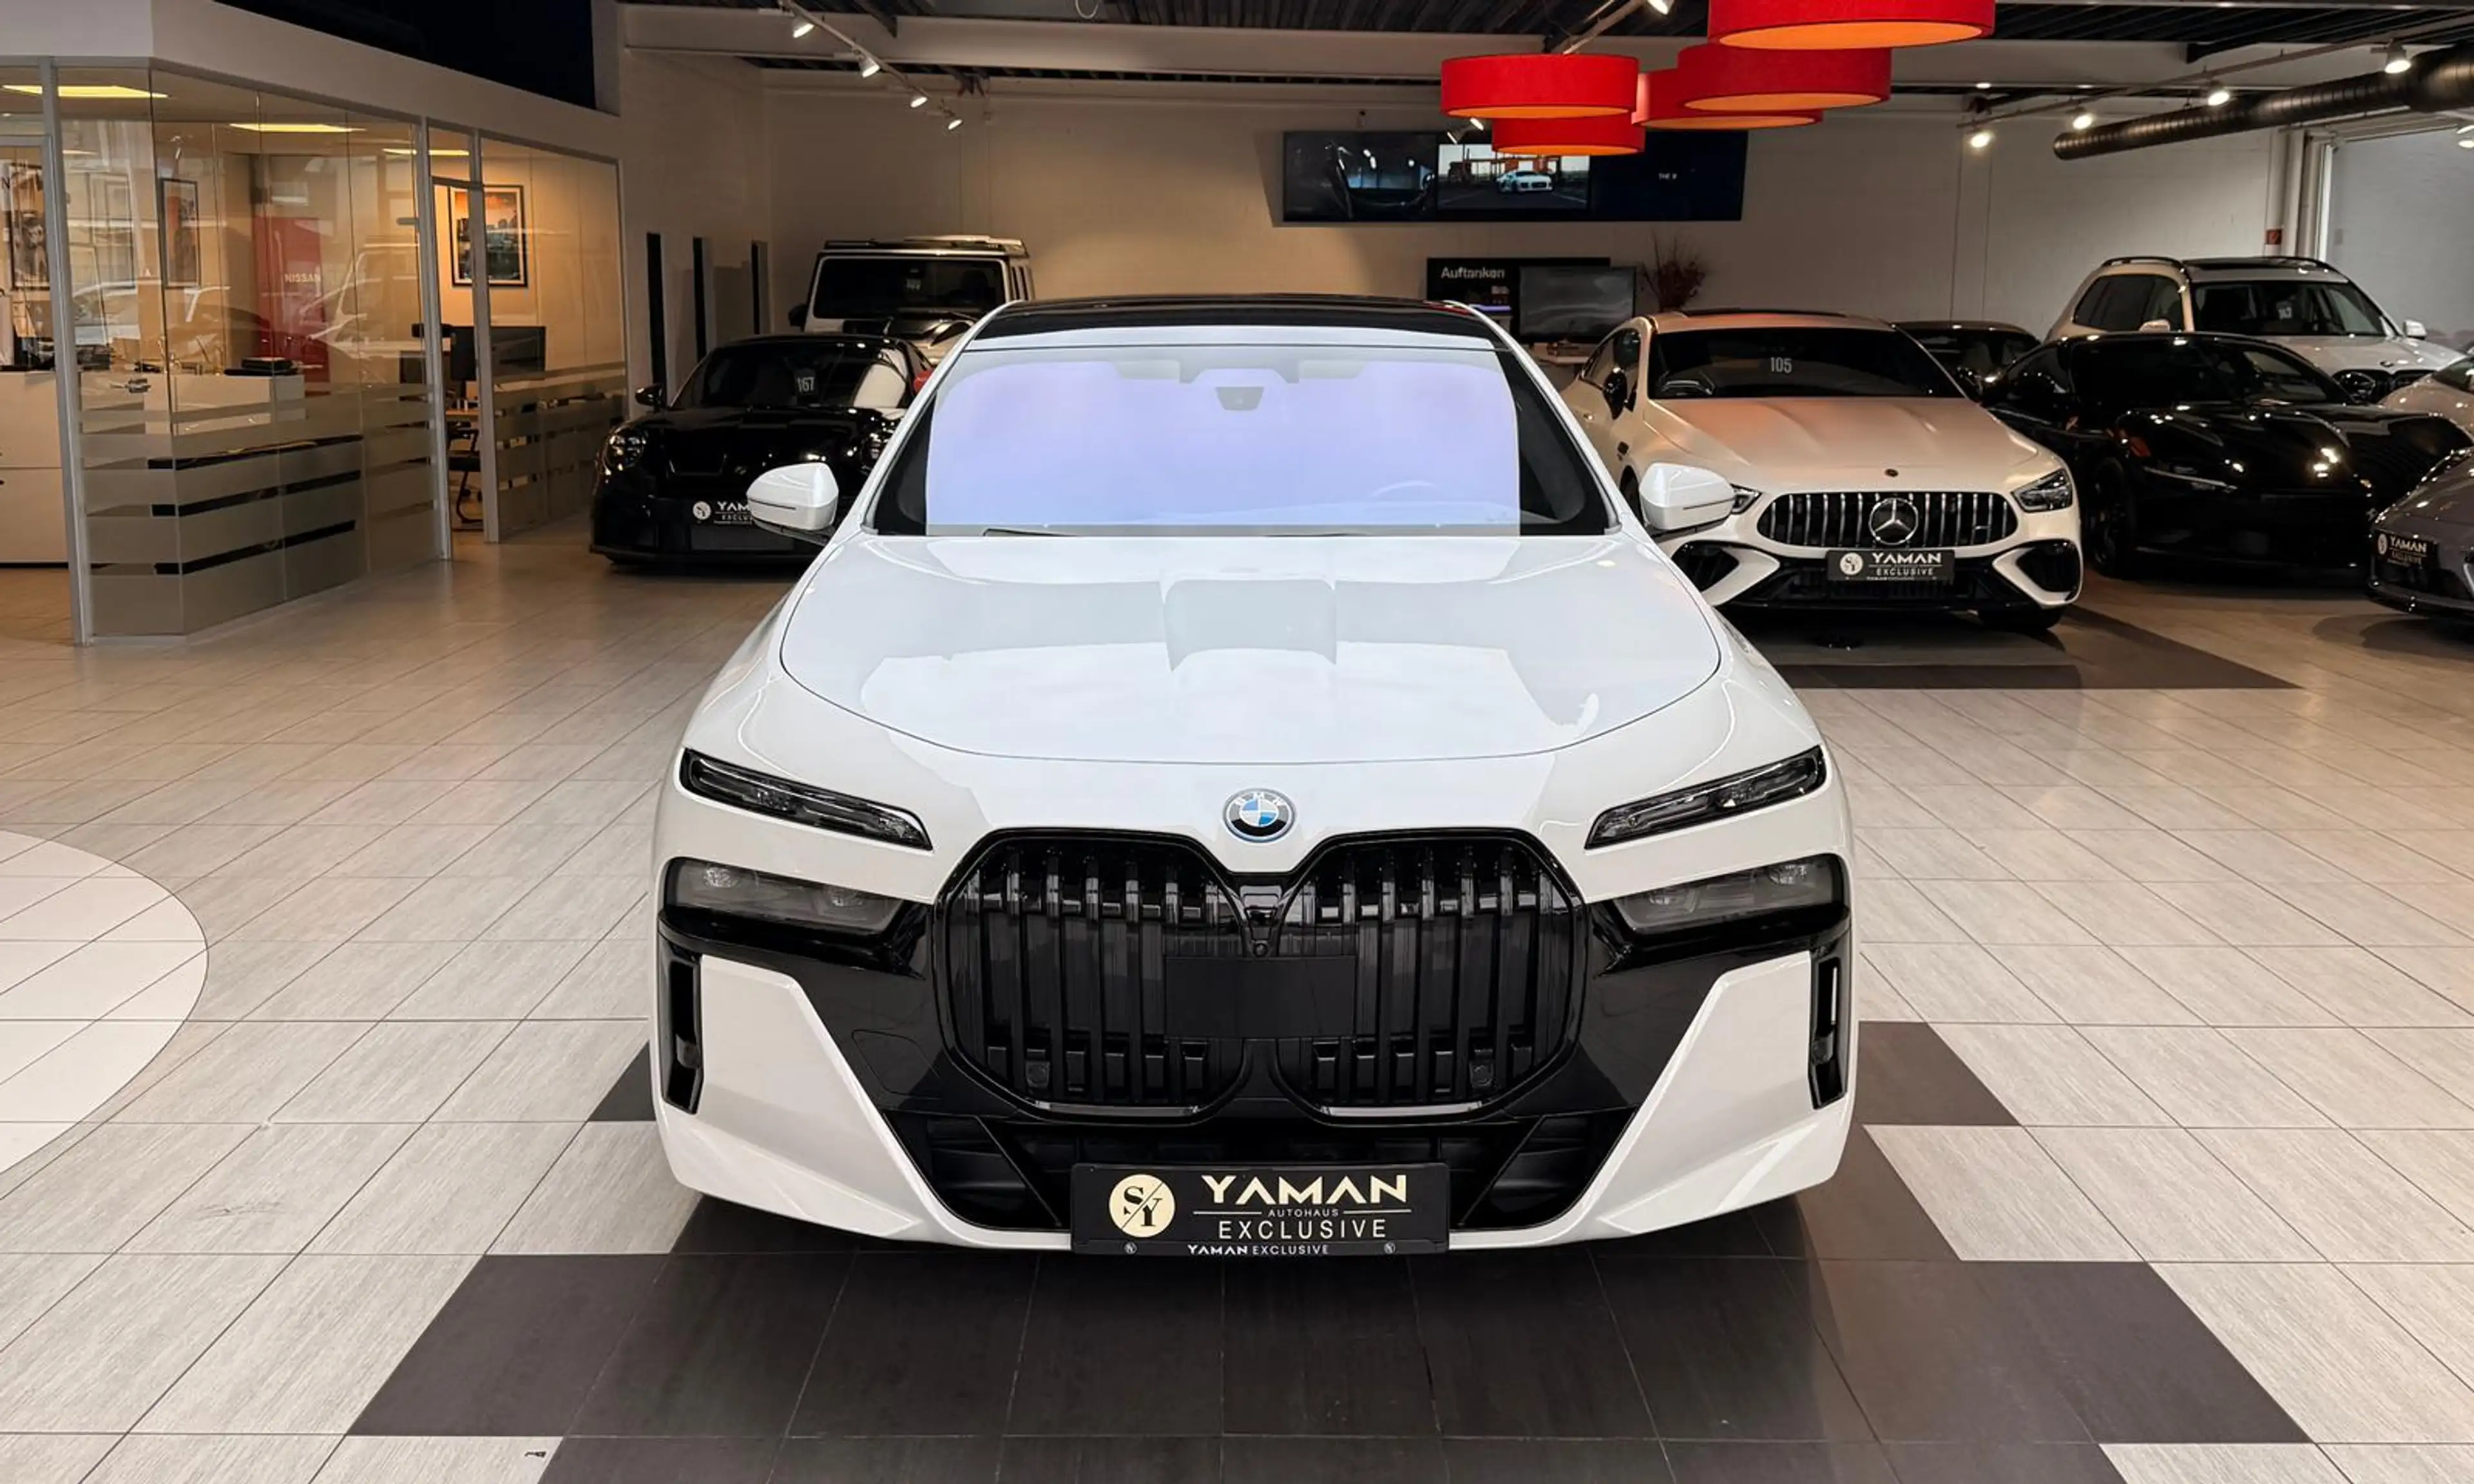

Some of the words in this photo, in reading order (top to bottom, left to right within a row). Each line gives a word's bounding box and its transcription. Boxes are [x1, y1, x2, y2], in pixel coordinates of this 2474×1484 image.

[284, 273, 321, 283] NISSAN
[1441, 267, 1505, 279] Auftanken
[1770, 357, 1792, 374] 105
[798, 377, 814, 392] 167
[717, 501, 749, 511] YAM
[2390, 535, 2427, 553] YAMAN
[1872, 552, 1941, 564] YAMAN
[1876, 567, 1933, 576] EXCLUSIVE
[1201, 1174, 1407, 1205] YAMAN
[1267, 1208, 1339, 1217] AUTOHAUS
[1219, 1219, 1386, 1240] EXCLUSIVE
[1187, 1244, 1248, 1255] YAMAN
[1252, 1244, 1328, 1255] EXCLUSIVE
